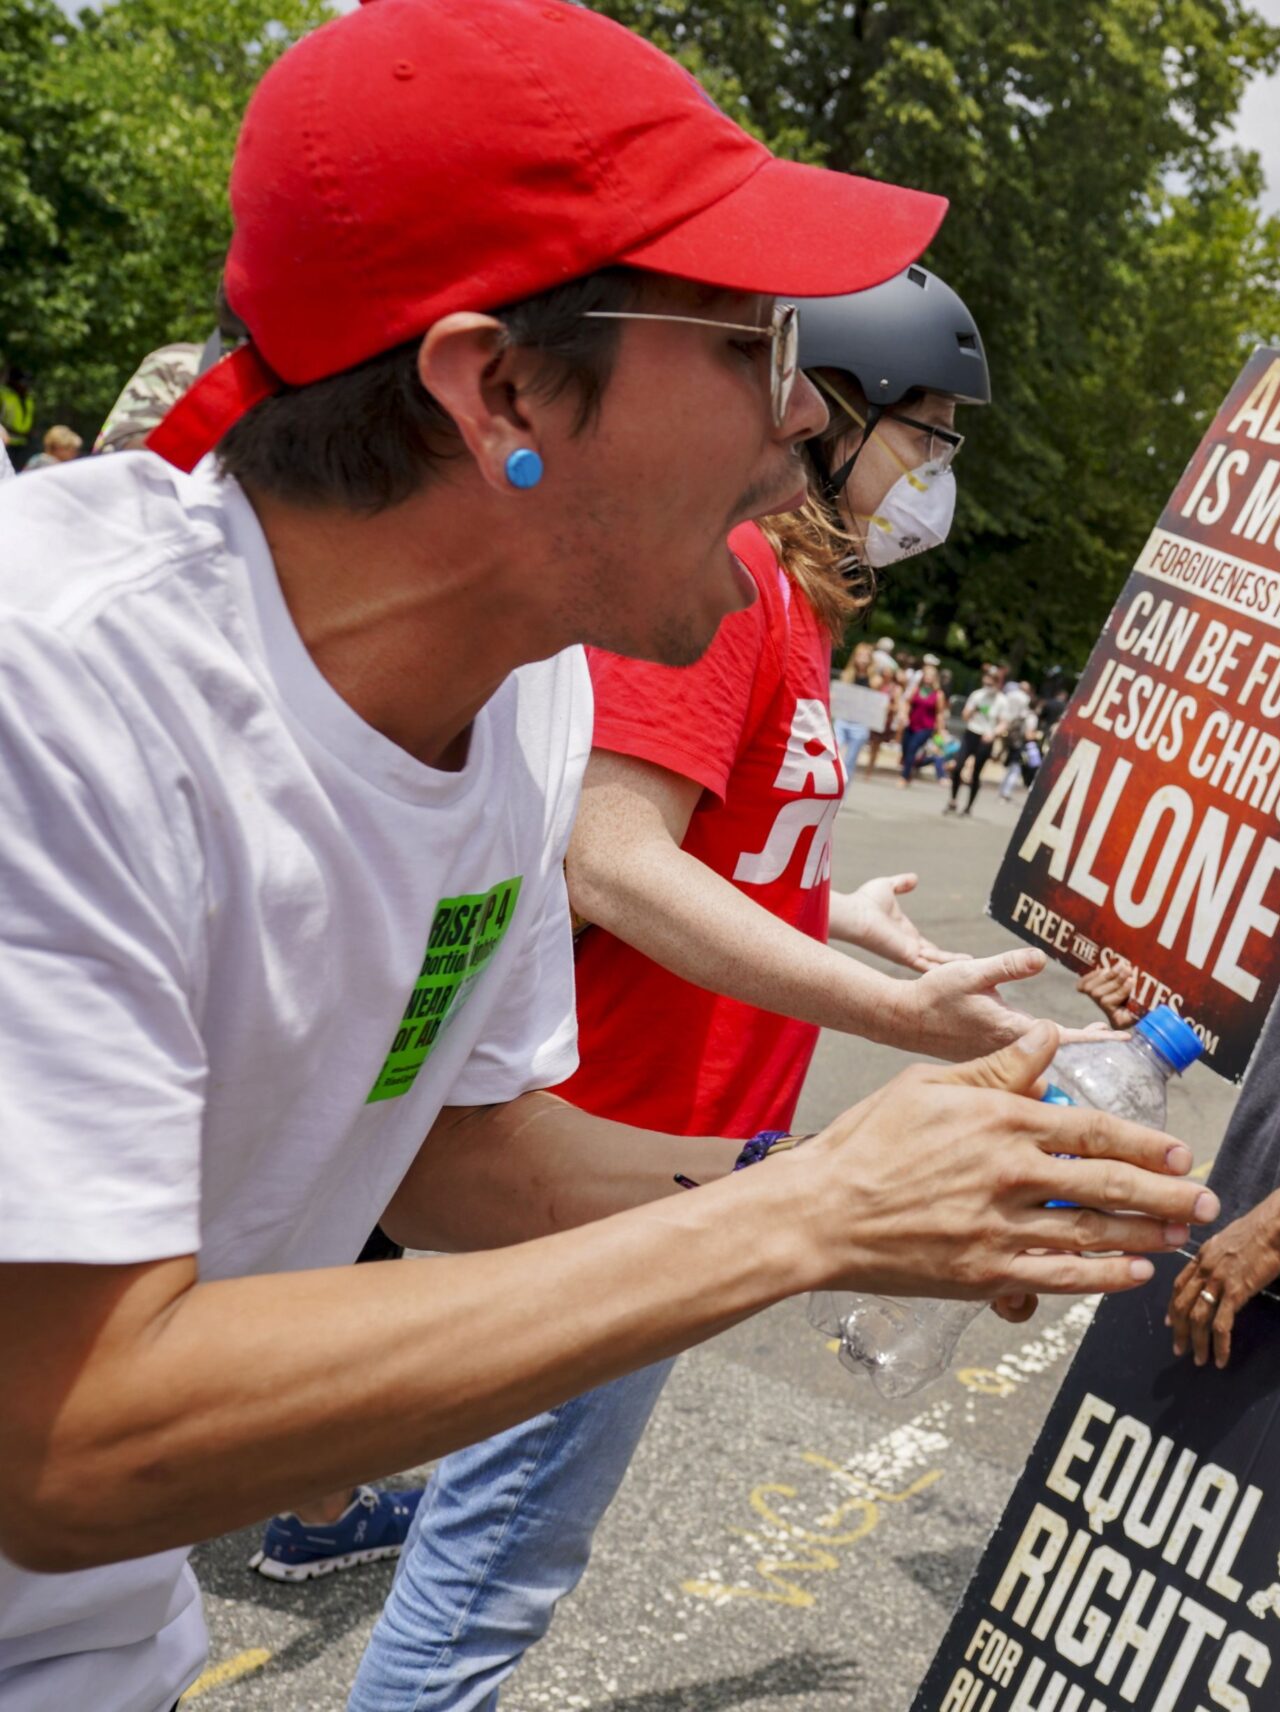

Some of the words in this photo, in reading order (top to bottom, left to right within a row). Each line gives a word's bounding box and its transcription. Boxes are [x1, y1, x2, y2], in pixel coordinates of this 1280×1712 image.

[1181, 444, 1249, 525] IS
[1150, 539, 1278, 613] FORGIVENESS
[1115, 591, 1199, 672] CAN
[1185, 620, 1253, 696] BE
[1077, 659, 1198, 762] JESUS
[1011, 892, 1075, 953] FREE
[1072, 934, 1099, 965] THE
[1045, 1392, 1264, 1603] EQUAL
[964, 1618, 1023, 1688] FOR
[990, 1502, 1272, 1712] RIGHTS
